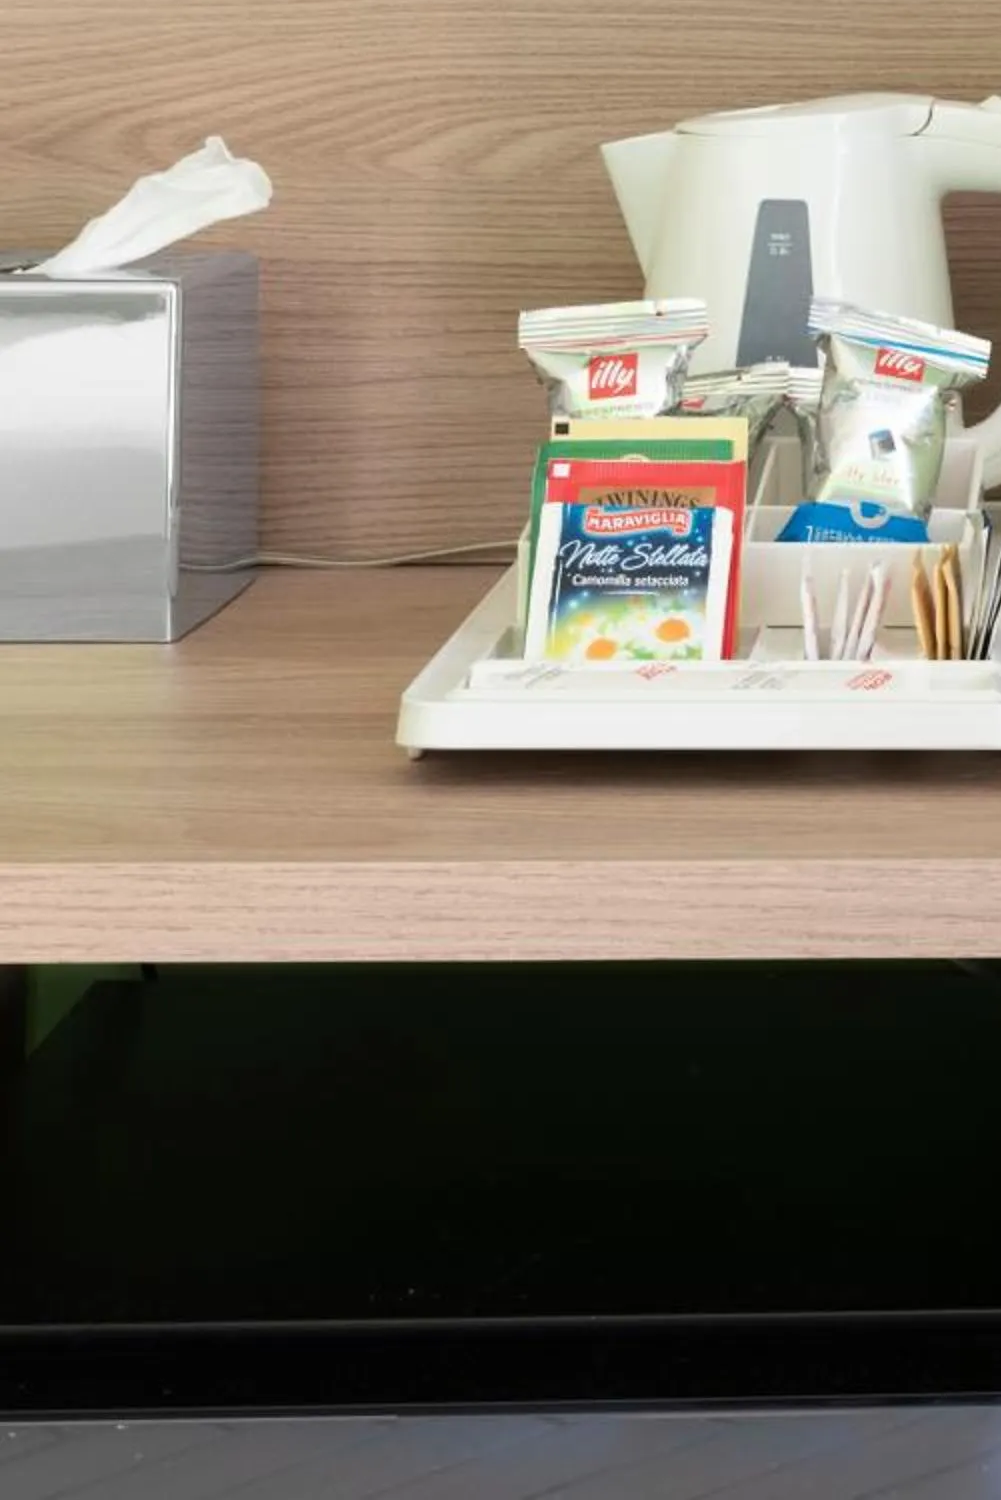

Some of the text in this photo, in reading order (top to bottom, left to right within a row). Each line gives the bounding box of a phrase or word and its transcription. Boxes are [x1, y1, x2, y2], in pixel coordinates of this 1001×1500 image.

[591, 359, 636, 394] illy
[879, 348, 923, 377] illy
[588, 510, 687, 532] MARAVIGLIA
[558, 539, 709, 571] Notte Stellata
[572, 573, 689, 589] Camomilla setacciata
